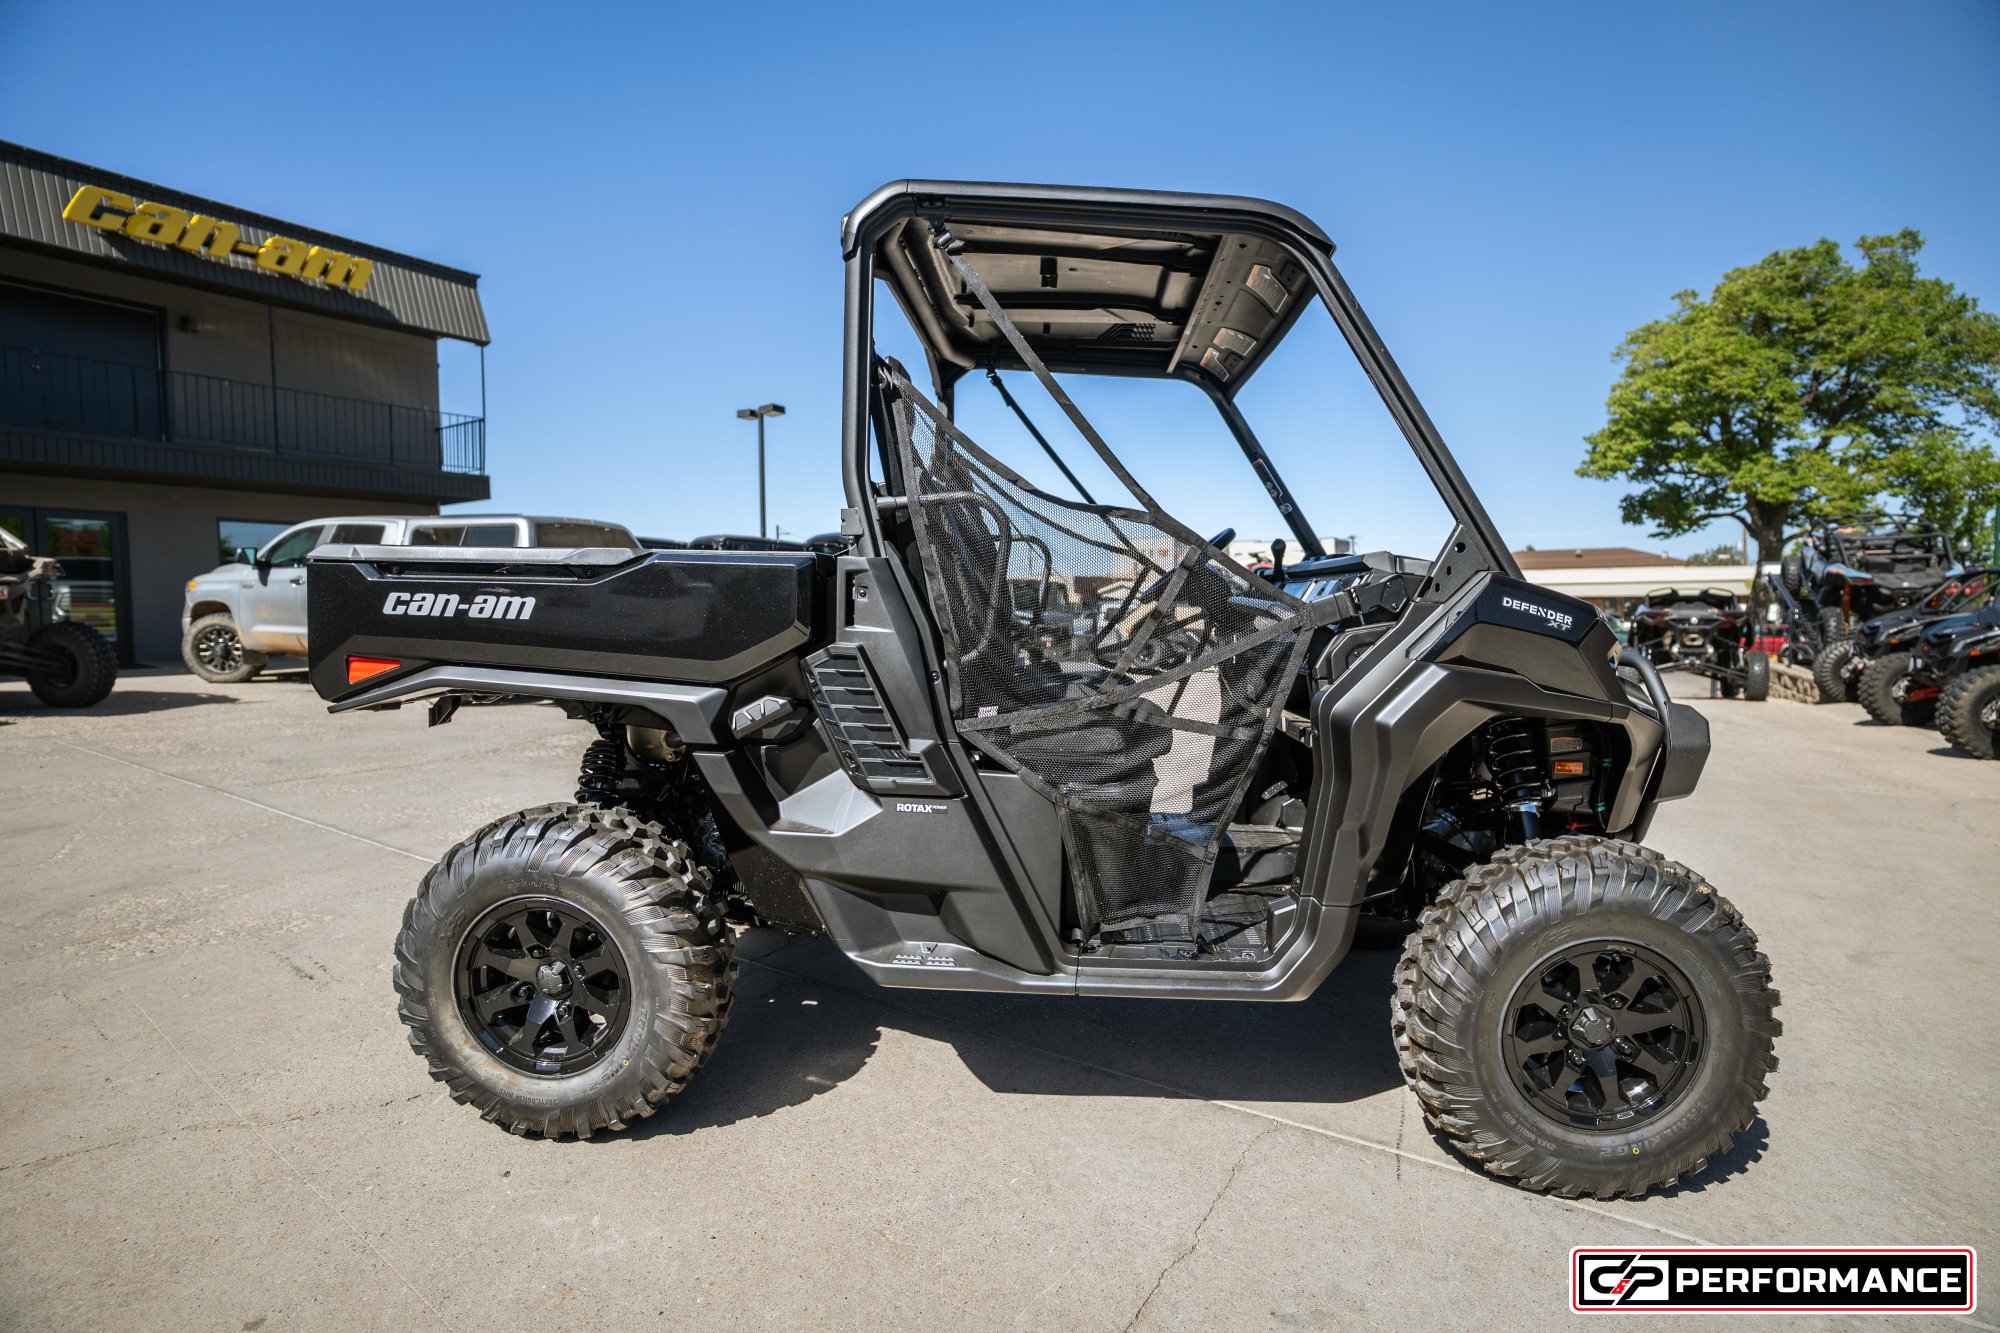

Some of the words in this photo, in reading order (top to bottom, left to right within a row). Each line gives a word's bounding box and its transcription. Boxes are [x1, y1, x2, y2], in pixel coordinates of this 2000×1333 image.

[62, 184, 374, 291] can-am
[382, 591, 536, 620] can-am
[1502, 596, 1573, 626] DEFENDER
[1546, 620, 1571, 631] XT
[896, 803, 932, 813] ROTAX
